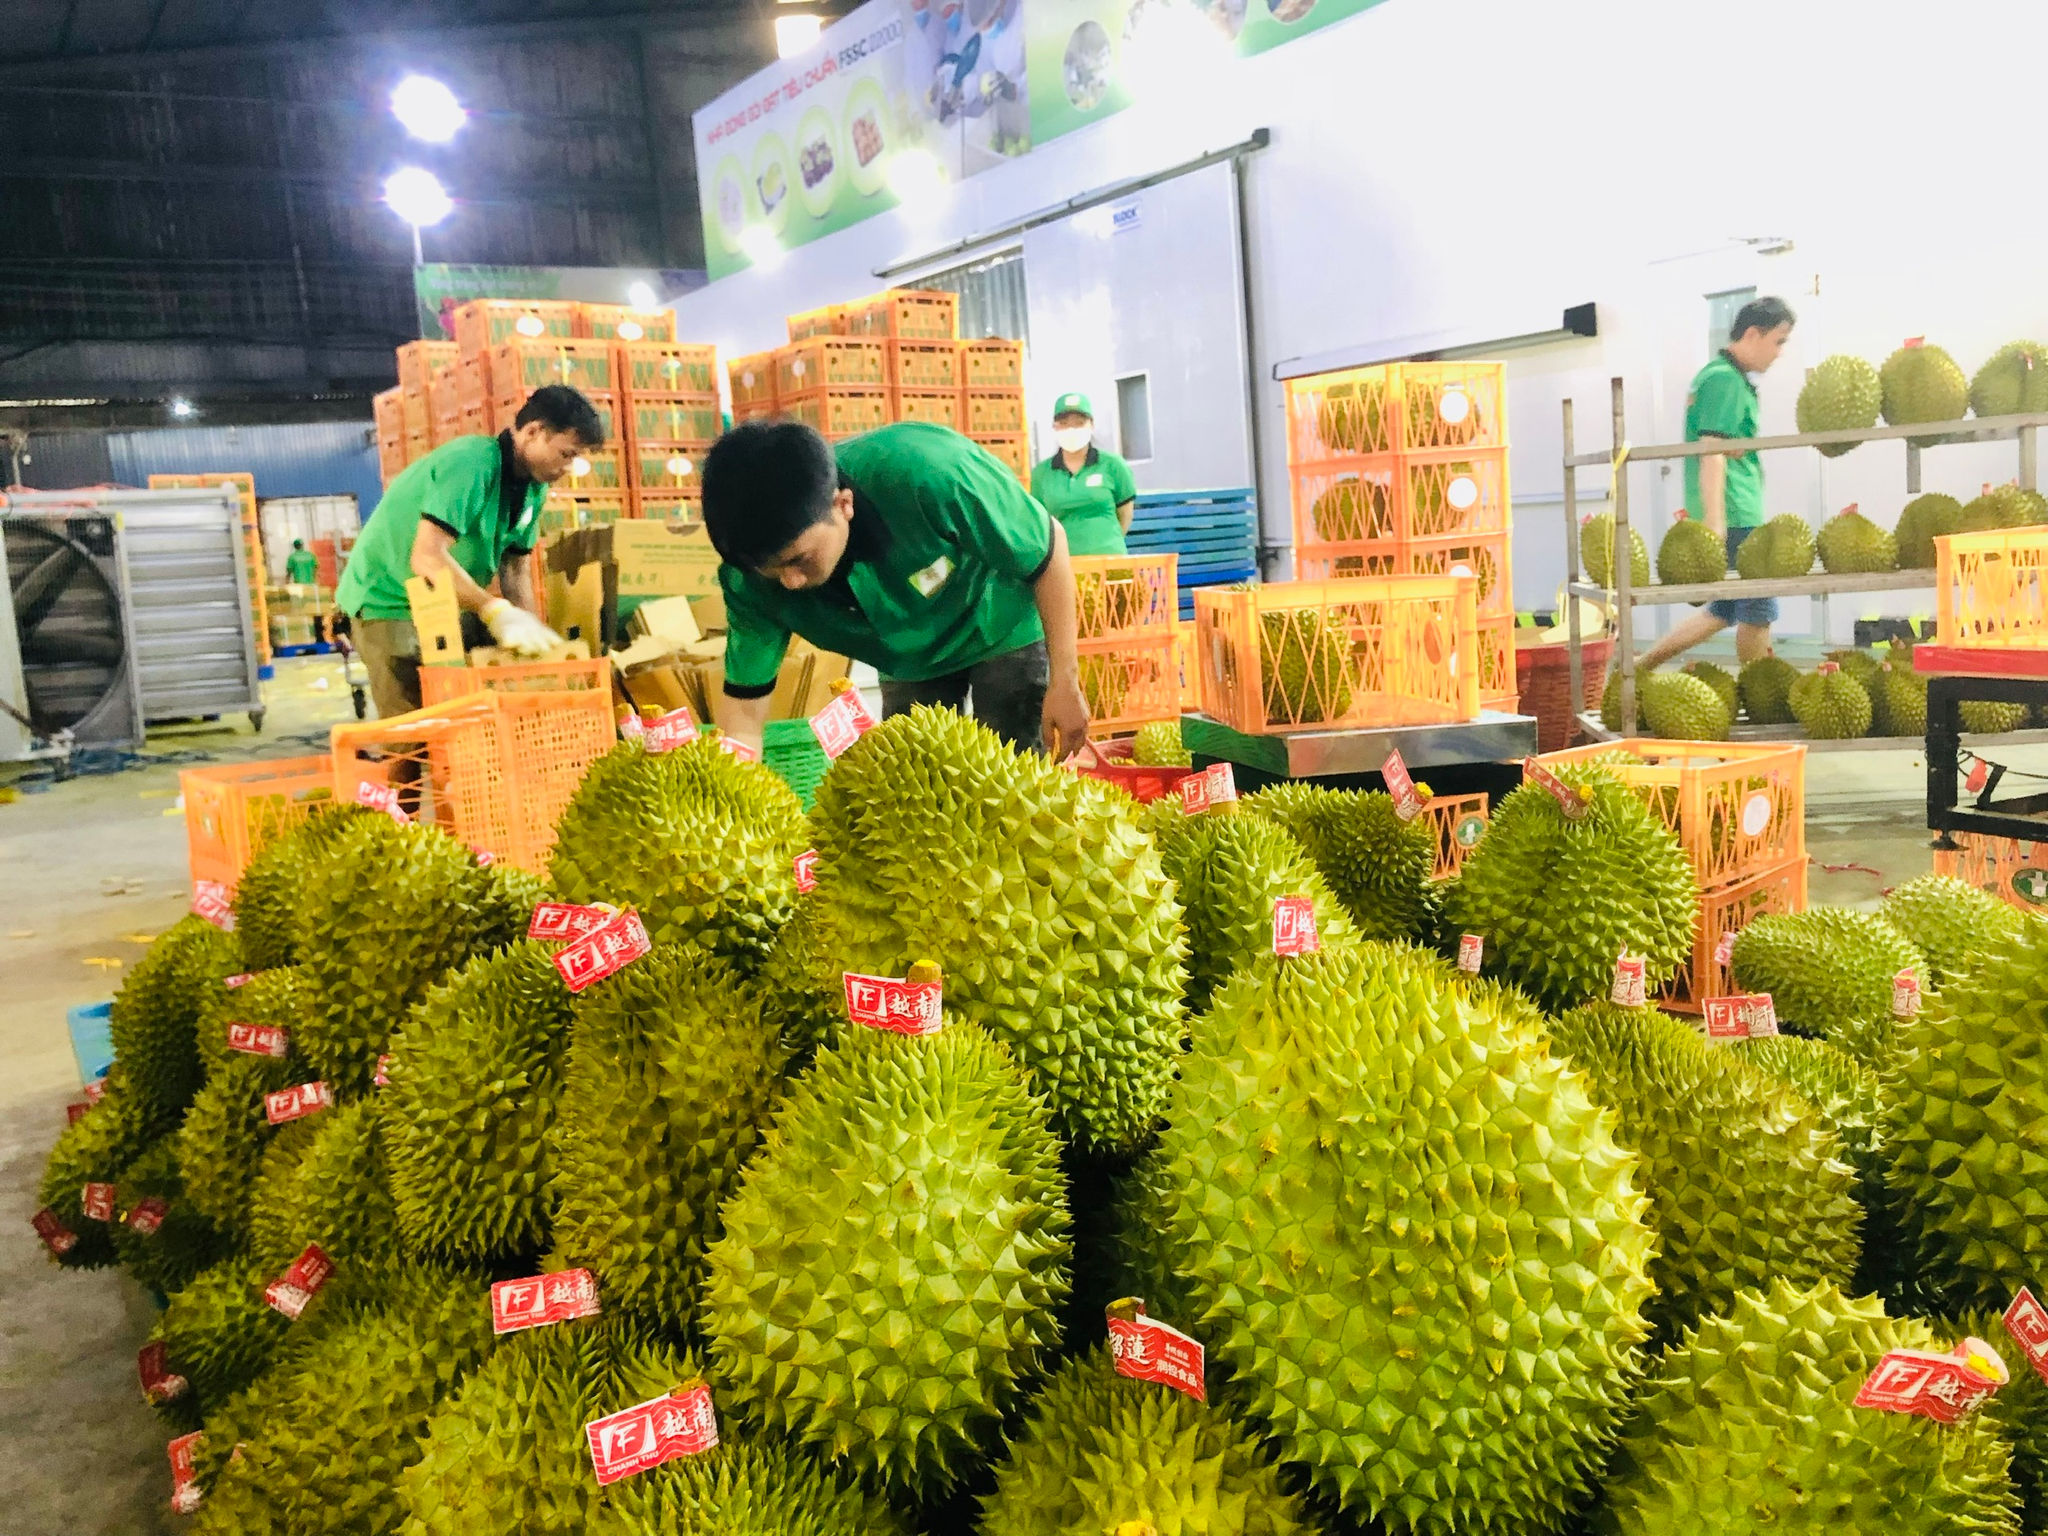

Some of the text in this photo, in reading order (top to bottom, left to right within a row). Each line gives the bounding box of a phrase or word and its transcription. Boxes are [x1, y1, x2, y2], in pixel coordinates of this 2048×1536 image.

[839, 37, 868, 69] FSSC
[660, 1398, 714, 1439] 越南
[606, 1450, 660, 1475] CHANH THU
